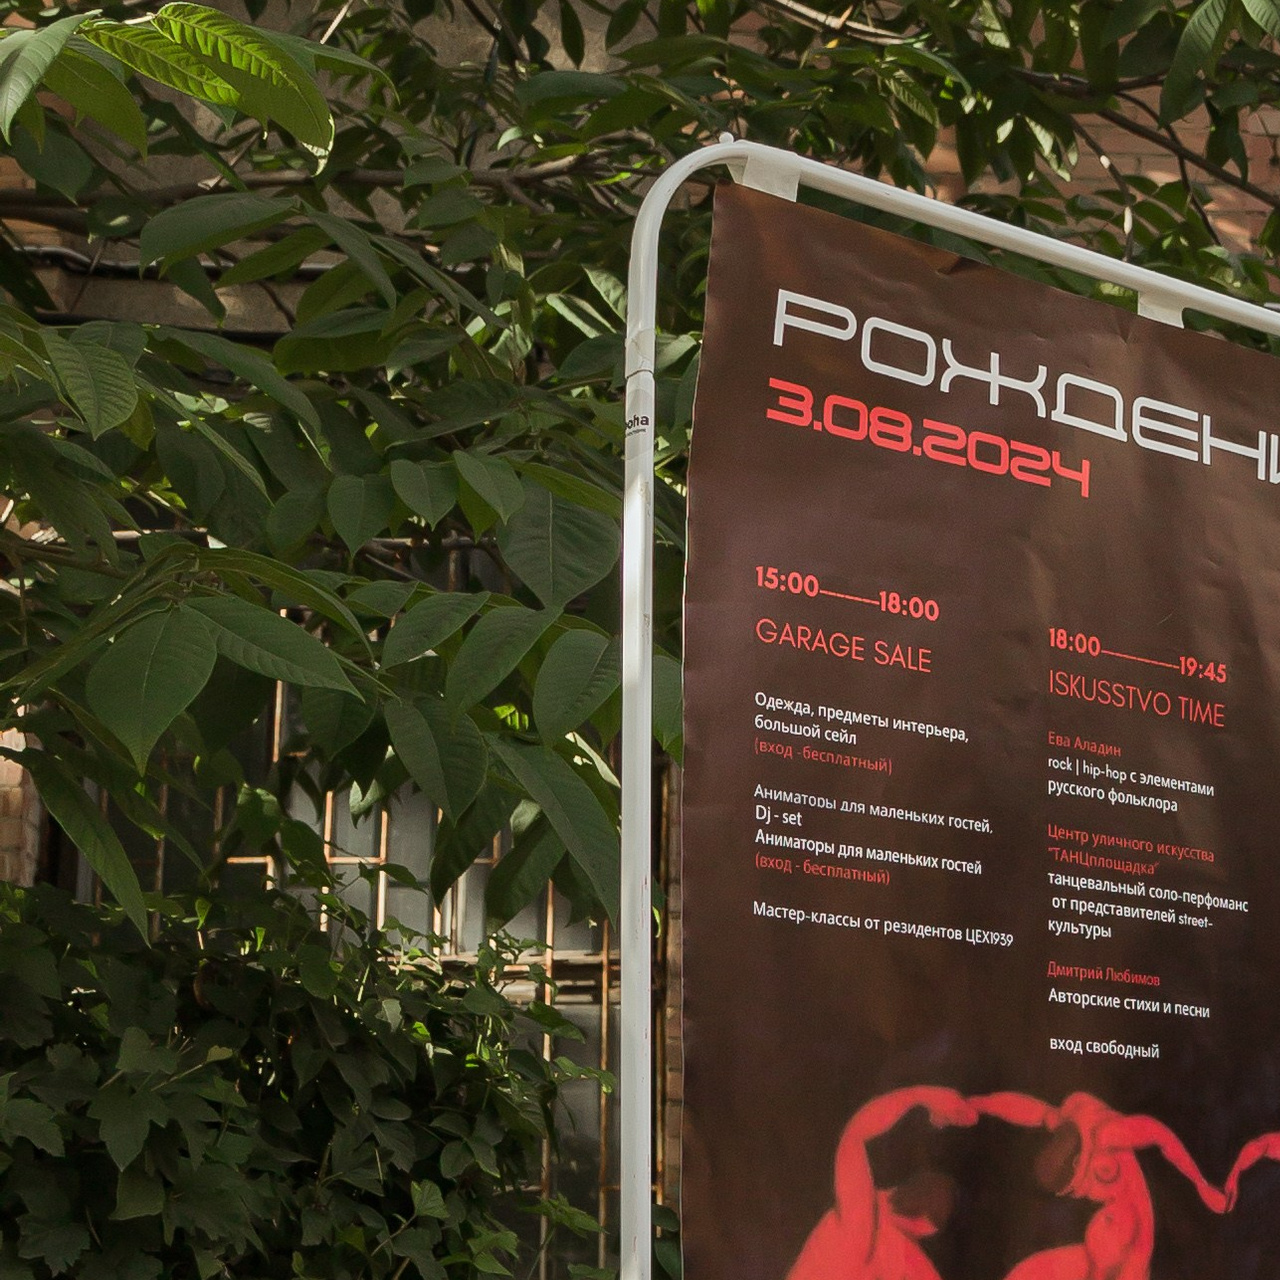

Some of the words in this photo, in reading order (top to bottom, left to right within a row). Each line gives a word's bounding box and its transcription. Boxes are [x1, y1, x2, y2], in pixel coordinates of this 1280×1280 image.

[765, 377, 1089, 499] 3.08.2024
[755, 618, 865, 661] GARAGE
[874, 640, 932, 673] SALE
[1049, 669, 1172, 716] ISKUSSTVO
[1178, 695, 1226, 727] TIME
[755, 691, 815, 717] Одежда,
[818, 705, 889, 728] предметы
[893, 718, 969, 743] интерьера,
[755, 714, 820, 739] большой
[824, 727, 857, 745] сейл
[755, 737, 793, 758] (вход
[1048, 730, 1071, 748] Ева
[1073, 736, 1122, 757] Аладин
[1048, 756, 1072, 771] rock
[1082, 759, 1127, 783] hip-hop
[1139, 771, 1215, 797] элементами
[840, 800, 865, 815] для
[870, 804, 945, 827] маленьких
[1048, 779, 1105, 801] русского
[1108, 788, 1178, 814] фольклора
[755, 804, 771, 825] Dj
[782, 811, 803, 826] set
[755, 828, 835, 856] Аниматоры
[838, 843, 863, 858] для
[866, 847, 939, 869] маленьких
[941, 857, 983, 875] гостей
[1048, 822, 1089, 846] Центр
[1092, 832, 1154, 852] уличного
[1157, 839, 1215, 863] искусства
[755, 851, 792, 874] (вход
[803, 859, 891, 885] бесплатный)
[1048, 872, 1146, 896] танцевальный
[1149, 885, 1249, 913] соло-перфоманс
[753, 900, 861, 927] Мастер-классы
[864, 918, 880, 930] от
[884, 919, 962, 940] резидентов
[966, 928, 1014, 948] ЦЕХ1939
[1052, 896, 1067, 909] от
[1070, 898, 1176, 924] представителей
[1048, 919, 1112, 941] культуры
[1047, 960, 1103, 982] Дмитрий
[1105, 967, 1160, 987] Любимов
[1048, 987, 1121, 1009] Авторские
[1123, 997, 1160, 1013] стихи
[1163, 1002, 1171, 1014] и
[1174, 1002, 1210, 1018] песни
[1049, 1037, 1083, 1054] вход
[1086, 1039, 1160, 1060] свободный
